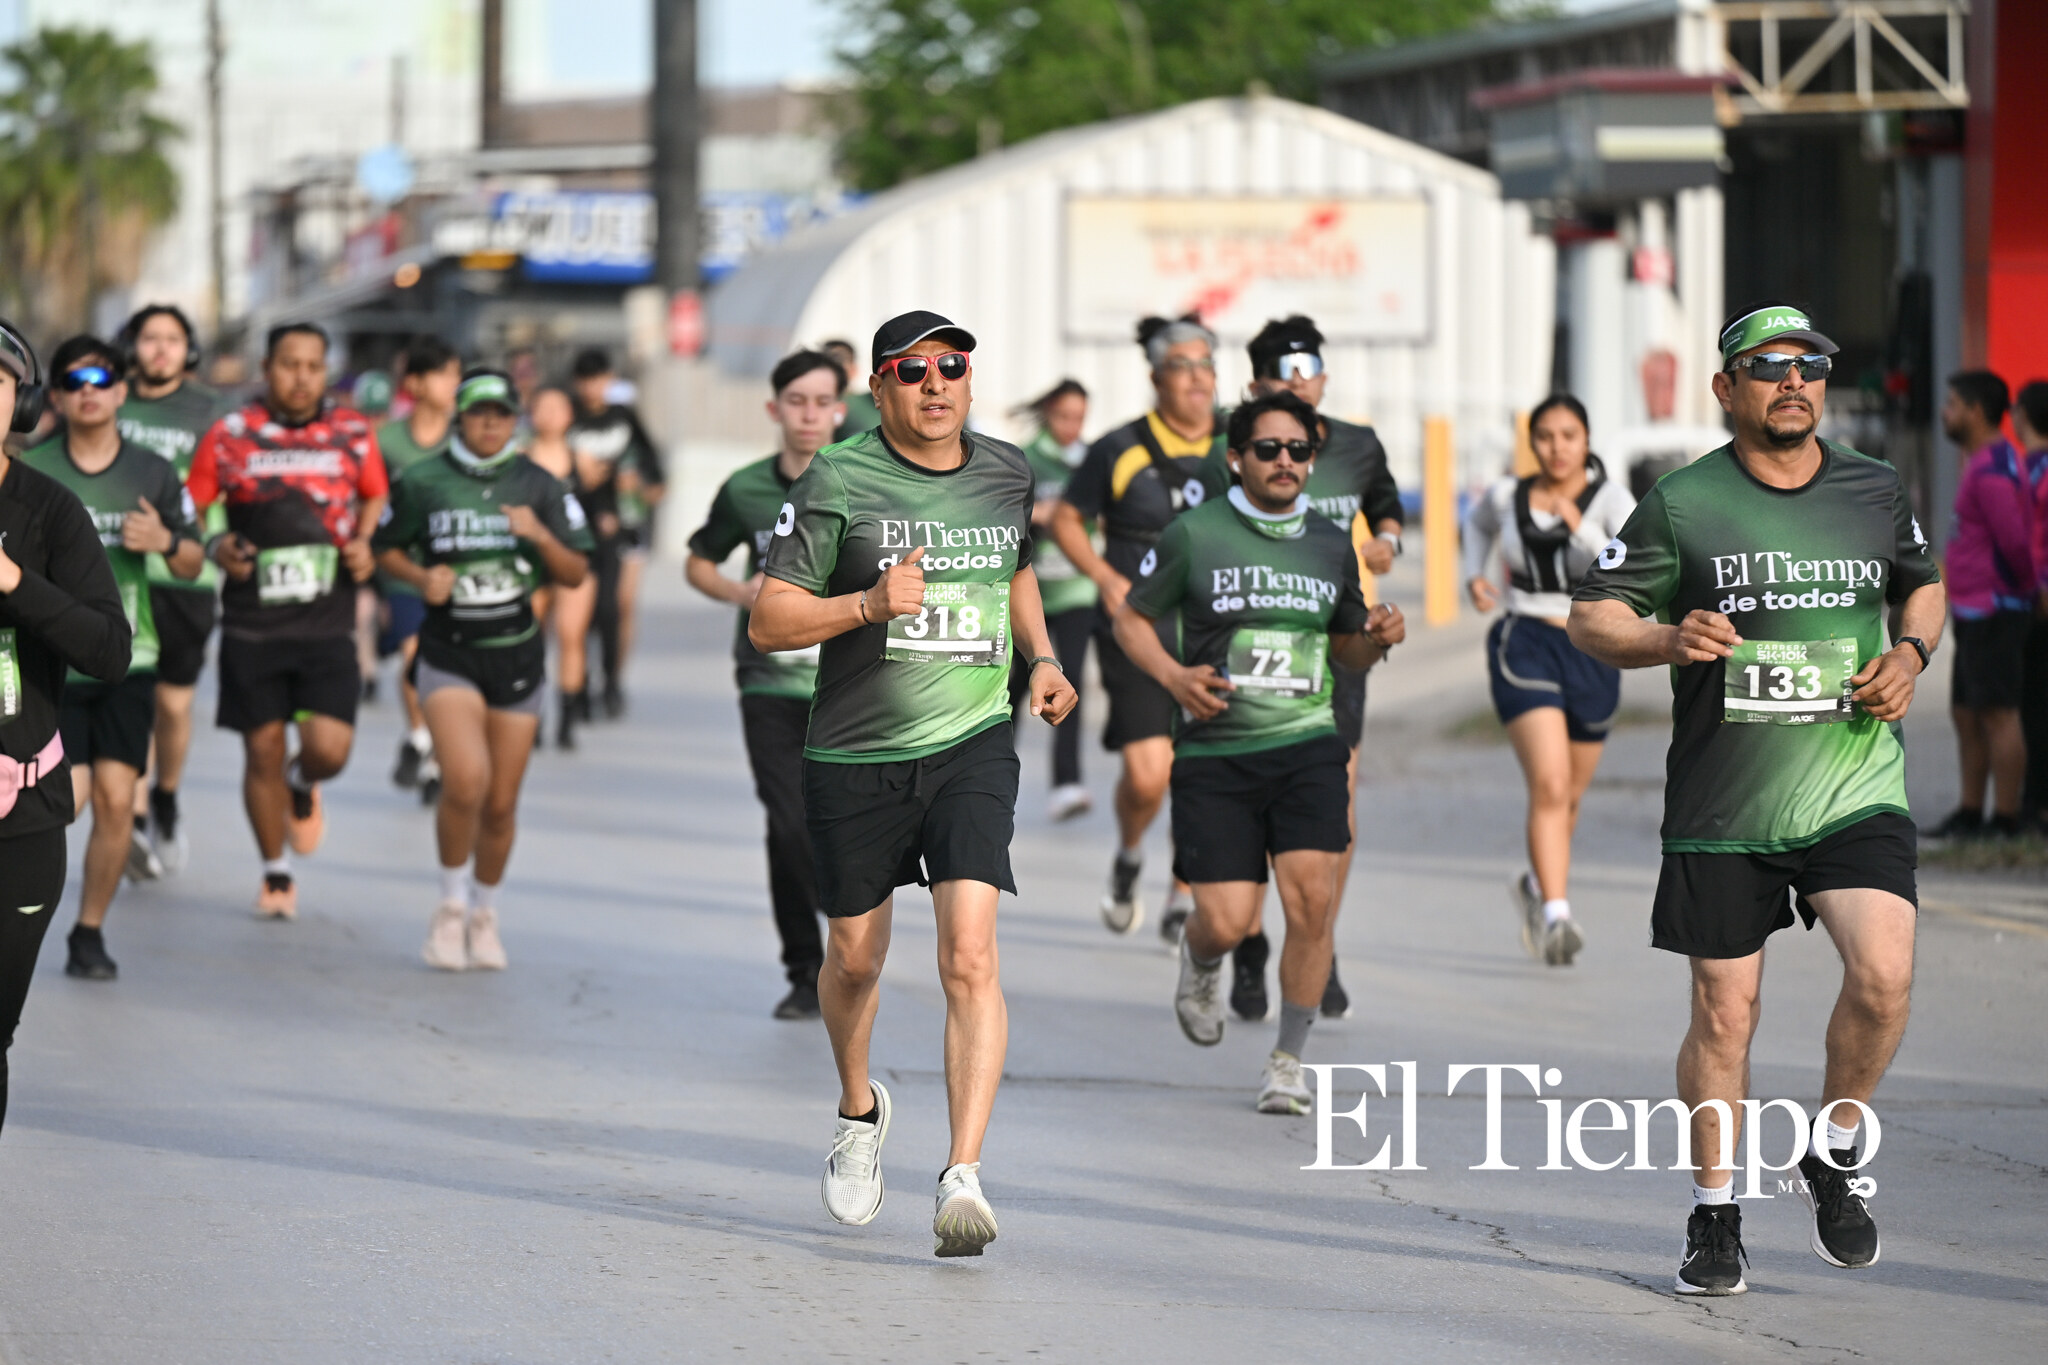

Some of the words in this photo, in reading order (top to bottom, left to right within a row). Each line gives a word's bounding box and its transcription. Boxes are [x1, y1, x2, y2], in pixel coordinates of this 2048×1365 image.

[878, 519, 913, 548] El
[915, 520, 1020, 552] Tiempo
[920, 552, 1003, 571] todos
[1710, 553, 1752, 589] El
[1755, 551, 1882, 589] Tiempo
[1212, 567, 1241, 594] El
[1244, 565, 1337, 600] Tiempo
[1212, 595, 1245, 613] de
[1247, 593, 1320, 614] todos
[1718, 594, 1757, 615] de
[1761, 588, 1857, 611] todos
[904, 605, 981, 640] 318
[996, 601, 1006, 656] MEDALLA
[1251, 648, 1292, 677] 72
[1841, 645, 1855, 653] 133
[1744, 664, 1822, 700] 133
[1842, 658, 1853, 713] MEDALLA
